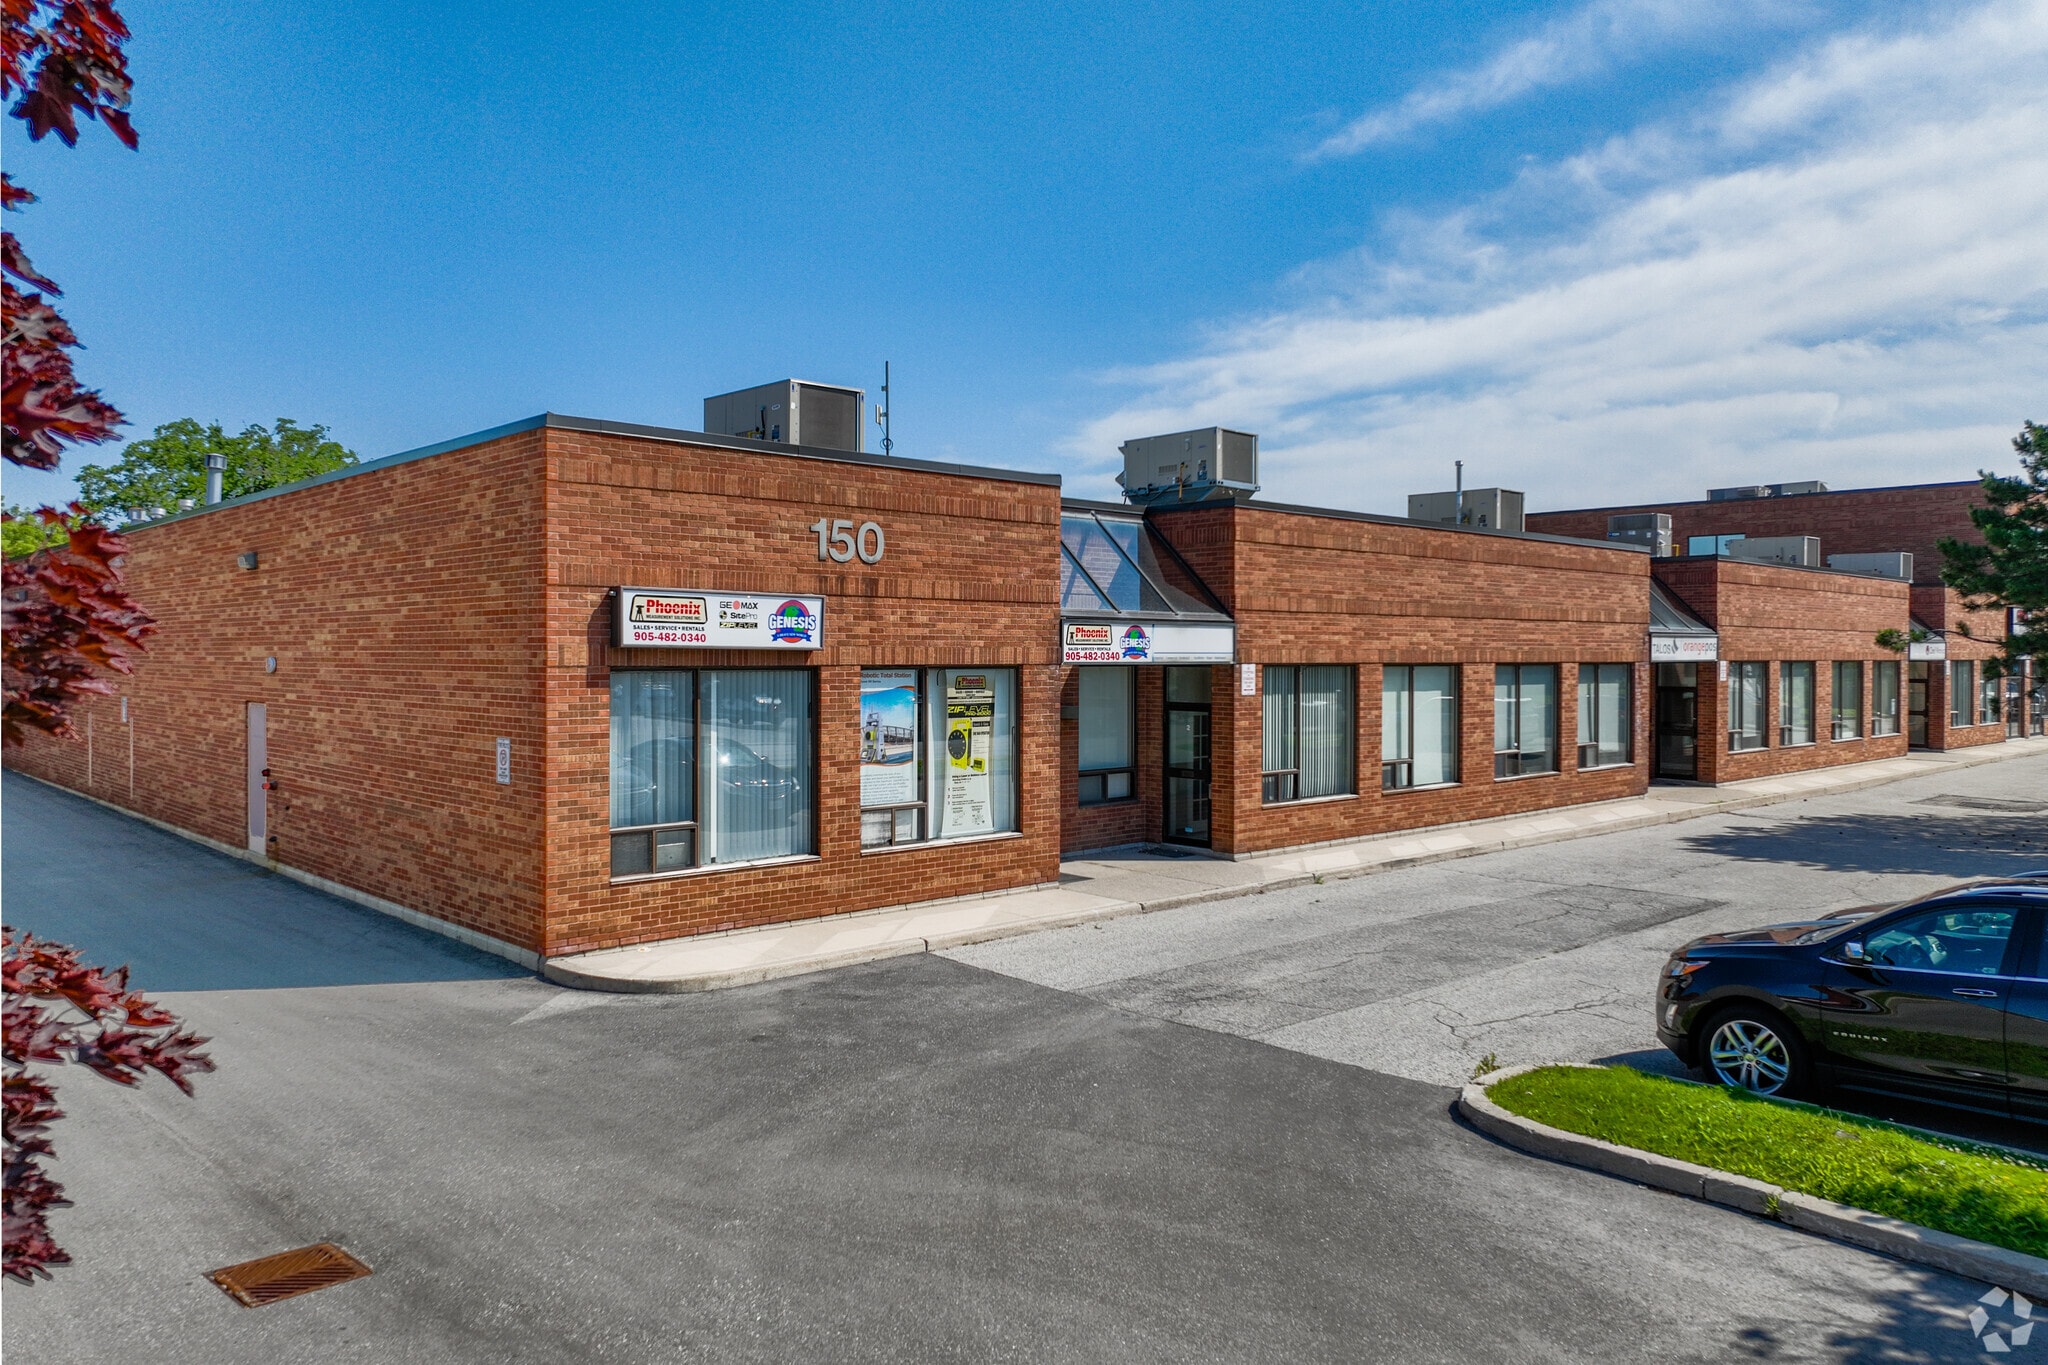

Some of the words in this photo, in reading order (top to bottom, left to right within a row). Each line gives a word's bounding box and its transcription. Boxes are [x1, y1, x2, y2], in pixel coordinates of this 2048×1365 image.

[809, 518, 885, 564] 150
[646, 599, 701, 615] Phoenix
[730, 612, 758, 620] SitePro
[768, 614, 816, 631] GENESIS
[634, 631, 706, 643] 905-482-0340
[1075, 626, 1108, 638] Phoenix
[1120, 636, 1151, 649] GENESIS
[1653, 643, 1671, 654] TALOS
[1683, 642, 1717, 655] orangepos
[1065, 651, 1120, 661] 905-482-0340
[961, 677, 984, 685] Phoenix
[1832, 1031, 1888, 1042] EQUINOX
